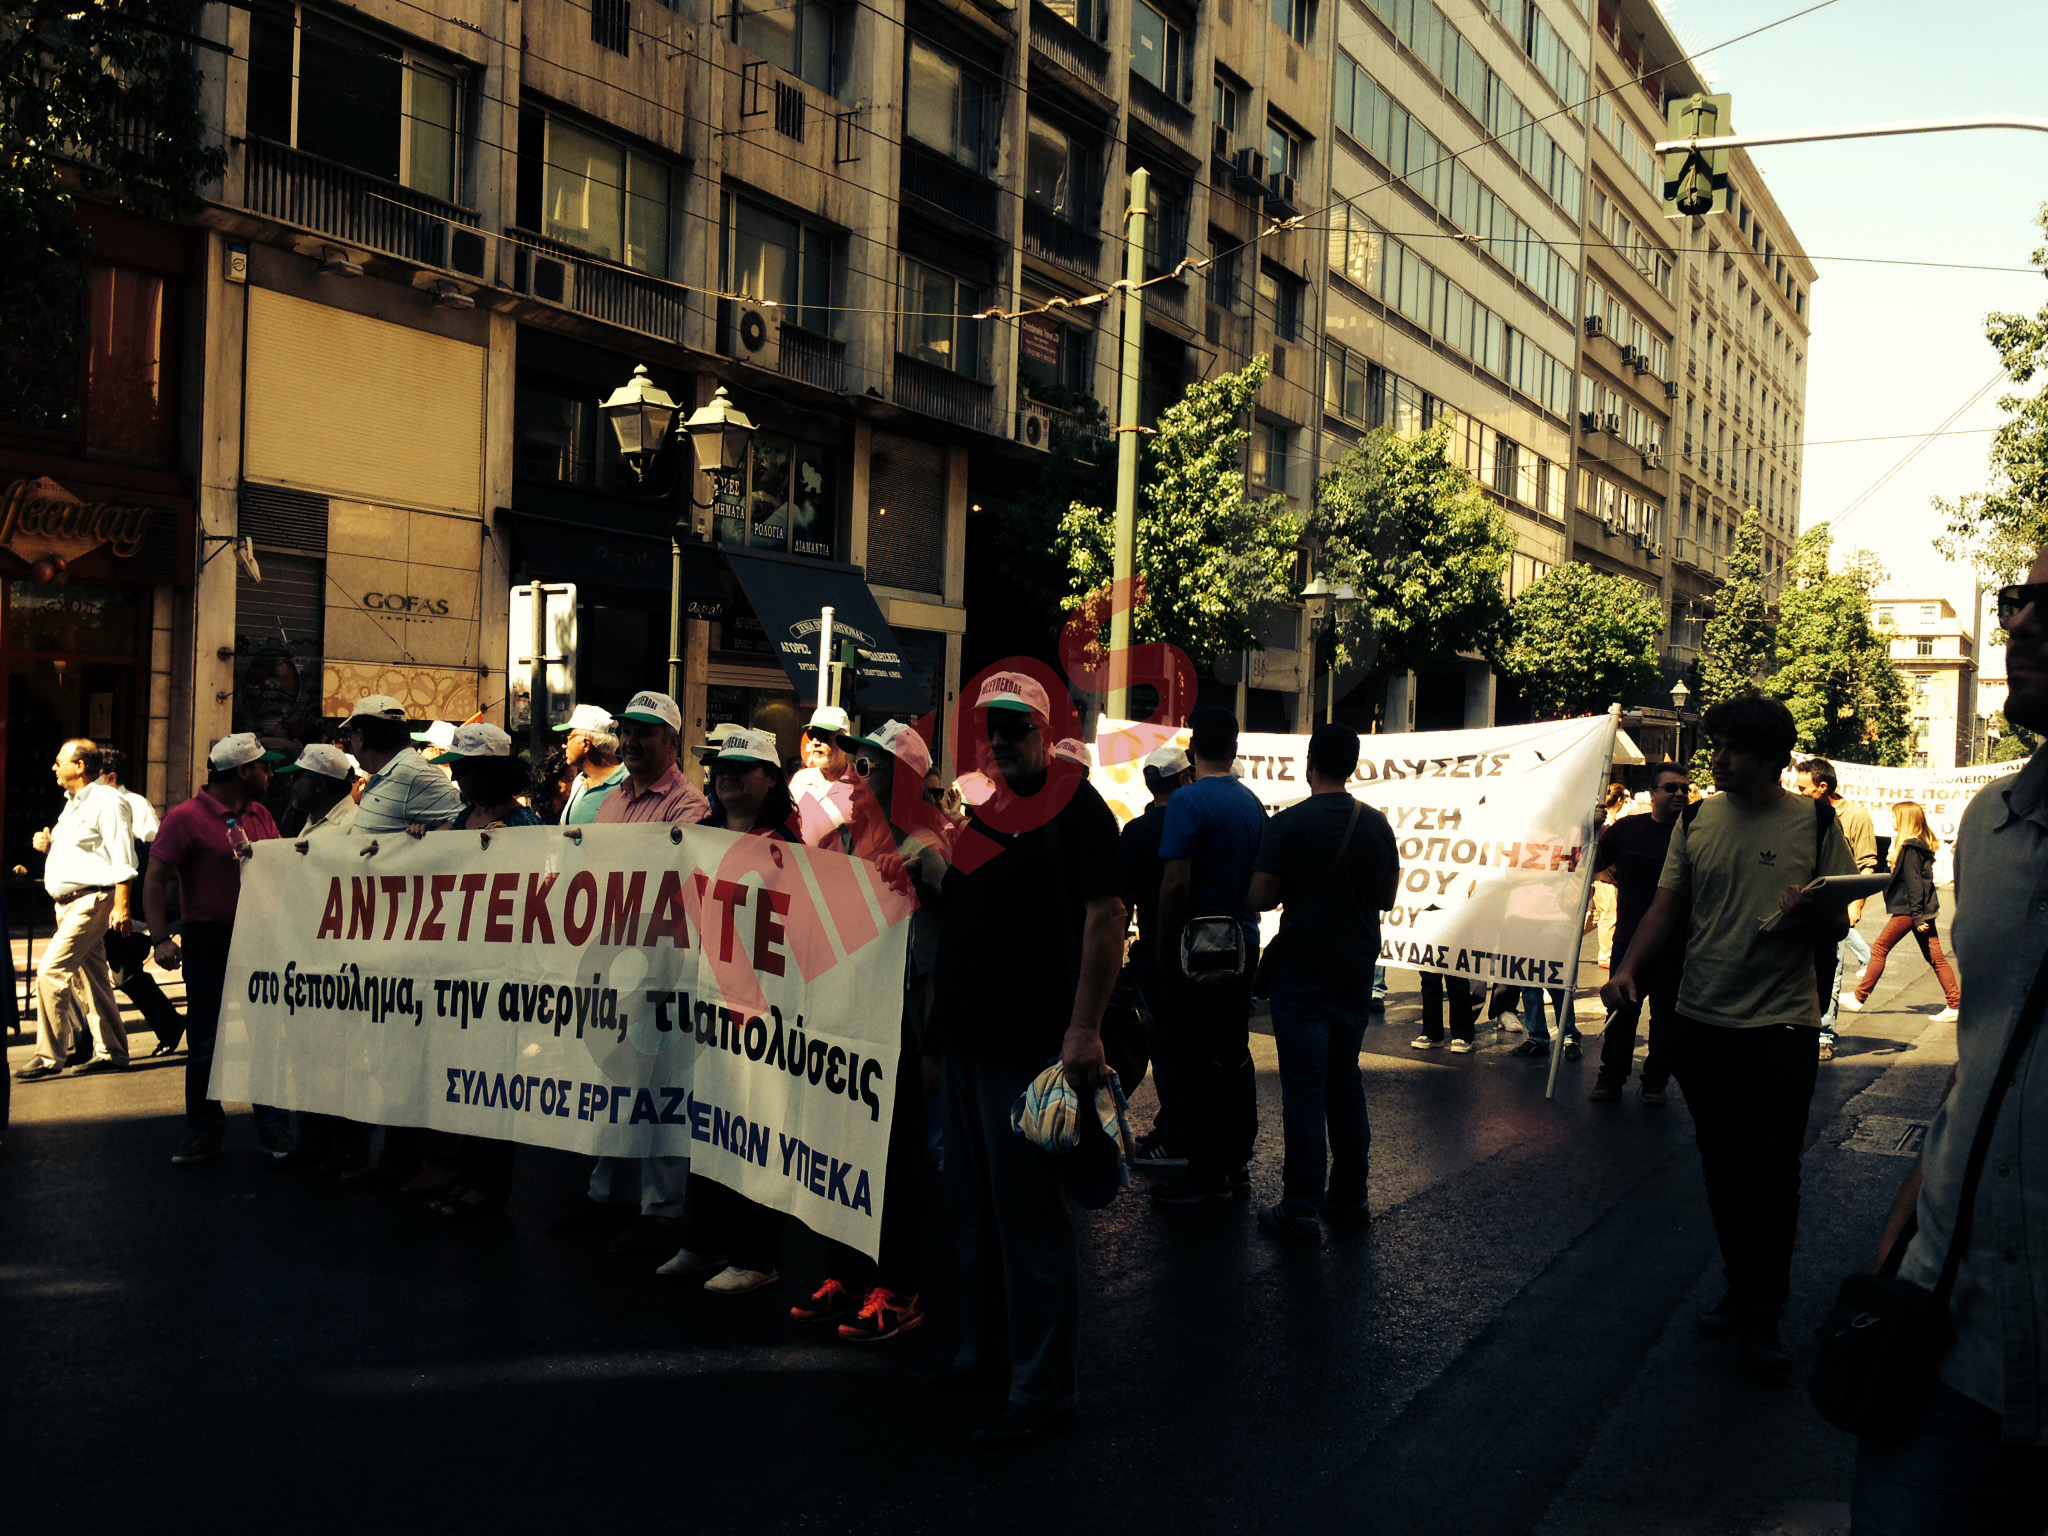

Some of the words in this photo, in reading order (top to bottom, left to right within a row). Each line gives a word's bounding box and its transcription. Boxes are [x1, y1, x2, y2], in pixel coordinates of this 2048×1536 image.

[714, 502, 745, 519] ΜΗΜΑΤΑ
[795, 540, 830, 556] ΔΙΑΜΑΝΤΙΑ
[363, 592, 449, 615] GOFAS
[780, 641, 812, 655] ΑΓΟΡΕΣ
[870, 651, 901, 664] ΩΛΗΣΕΙΣ
[1346, 753, 1511, 783] ΟΛΥΣΕΙΣ
[1876, 787, 1915, 799] ΤΗΣ
[1922, 788, 1981, 800] ΠΟΛΙΤ
[1380, 807, 1462, 831] ΥΣΗ
[1395, 836, 1582, 873] ΟΠΟΙΗΣΗ
[316, 870, 791, 977] ΑΝΤΙΣΤΕΚΟΜΑΤΕ
[1455, 948, 1565, 985] ΑΤΤΙΚΗΣ
[248, 970, 279, 1005] στο
[284, 960, 423, 1027] ξεπούλημα,
[433, 979, 490, 1030] την
[498, 973, 628, 1043] ανεργία,
[446, 1067, 573, 1118] ΣΥΛΛΟΓΟΣ
[778, 1131, 873, 1218] ΥΠΕΚΑ
